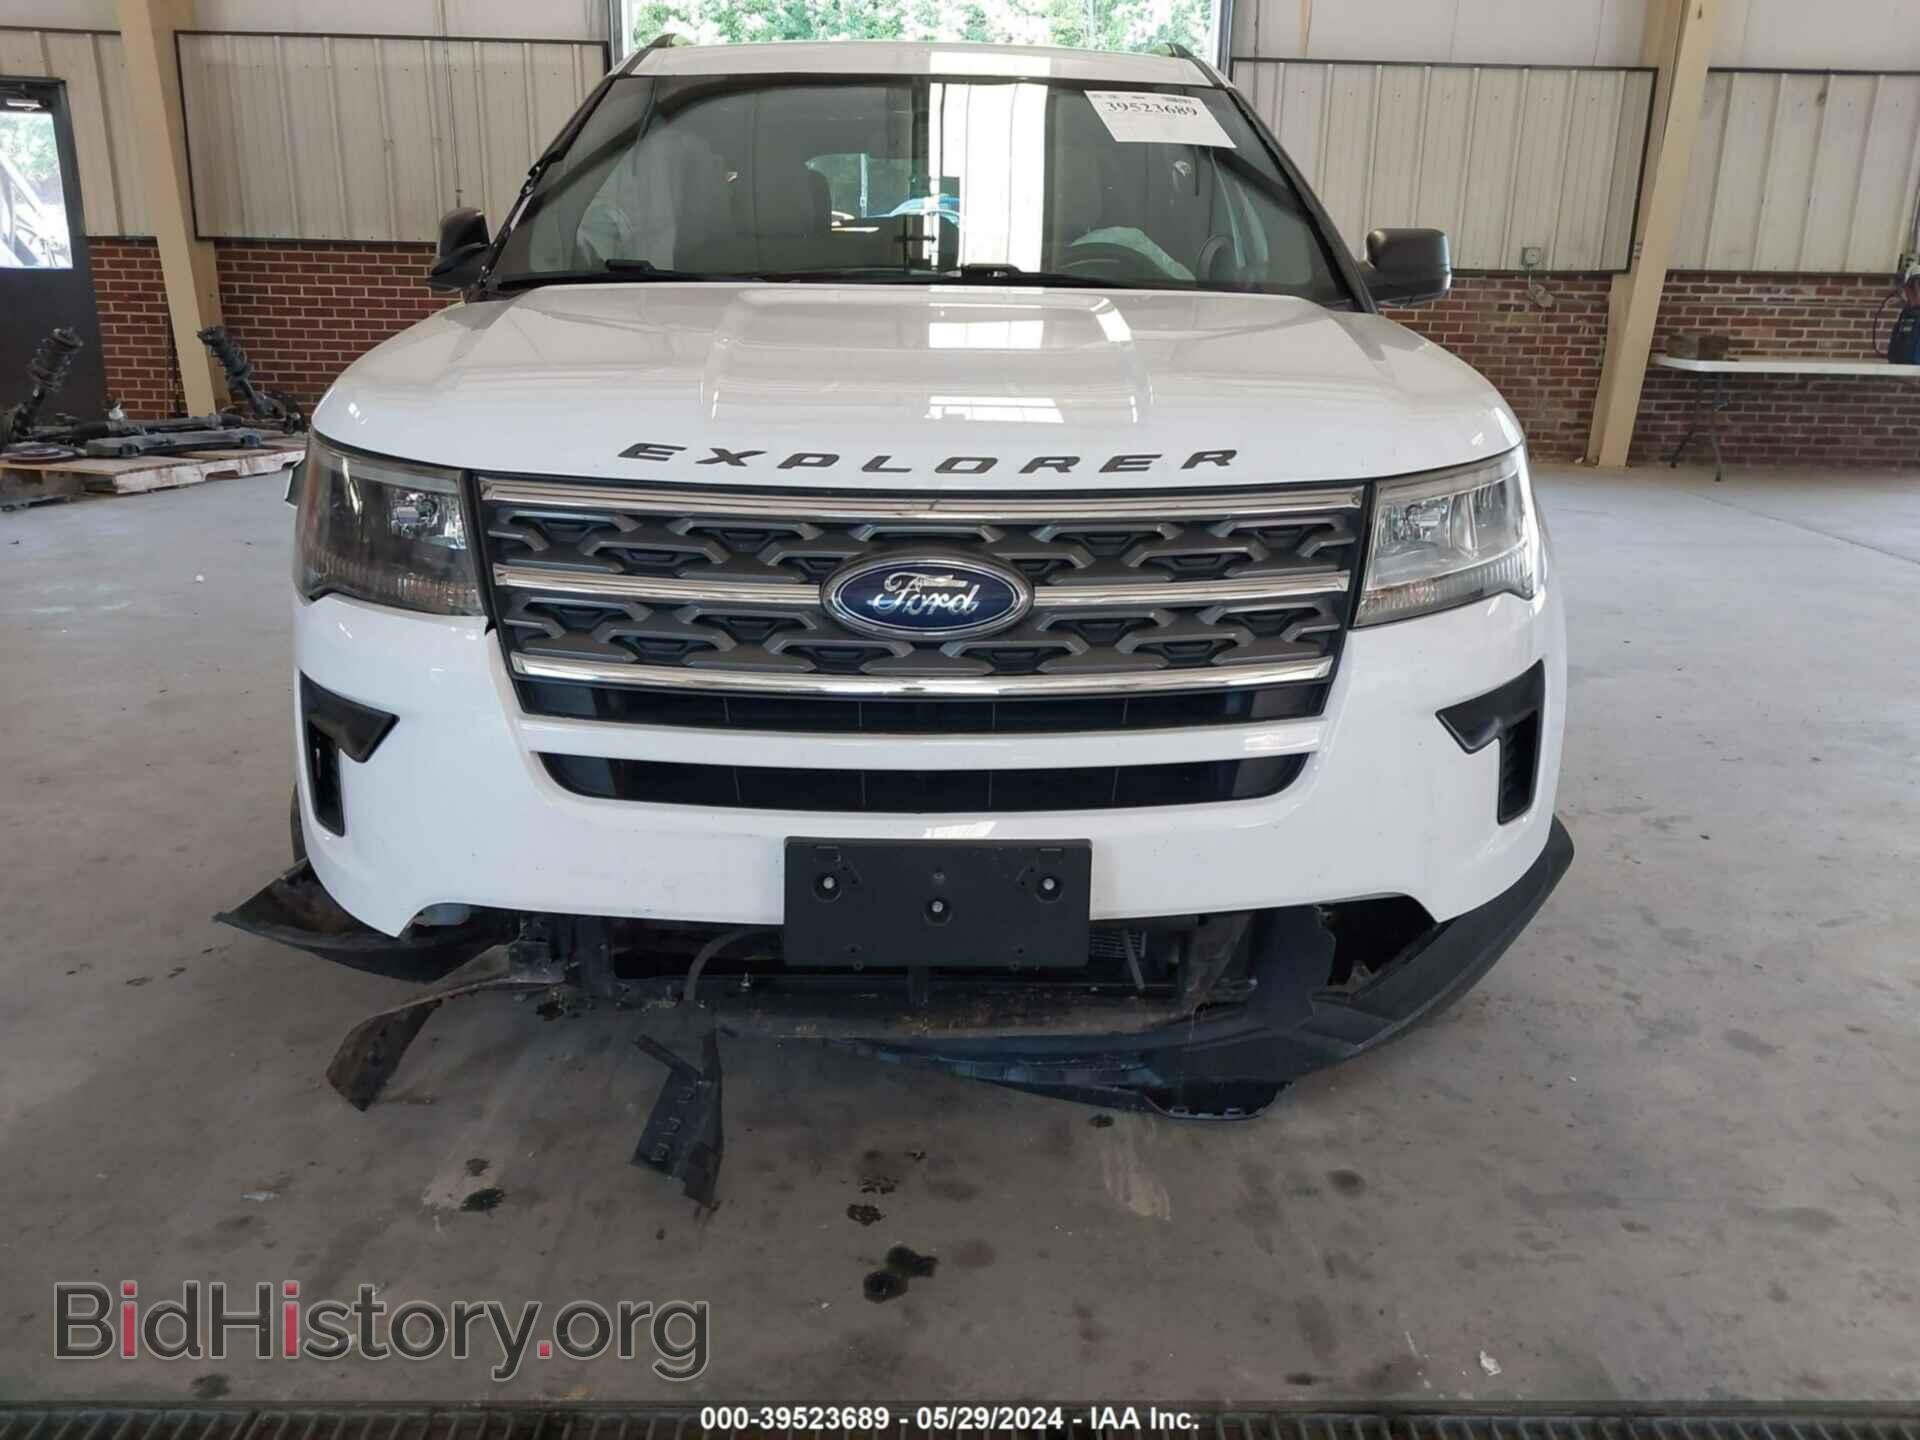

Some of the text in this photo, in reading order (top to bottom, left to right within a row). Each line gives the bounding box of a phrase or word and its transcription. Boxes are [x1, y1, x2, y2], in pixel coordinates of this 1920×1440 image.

[1104, 101, 1199, 117] 39523689
[617, 442, 1238, 475] EXPLORER
[866, 572, 980, 616] Ford
